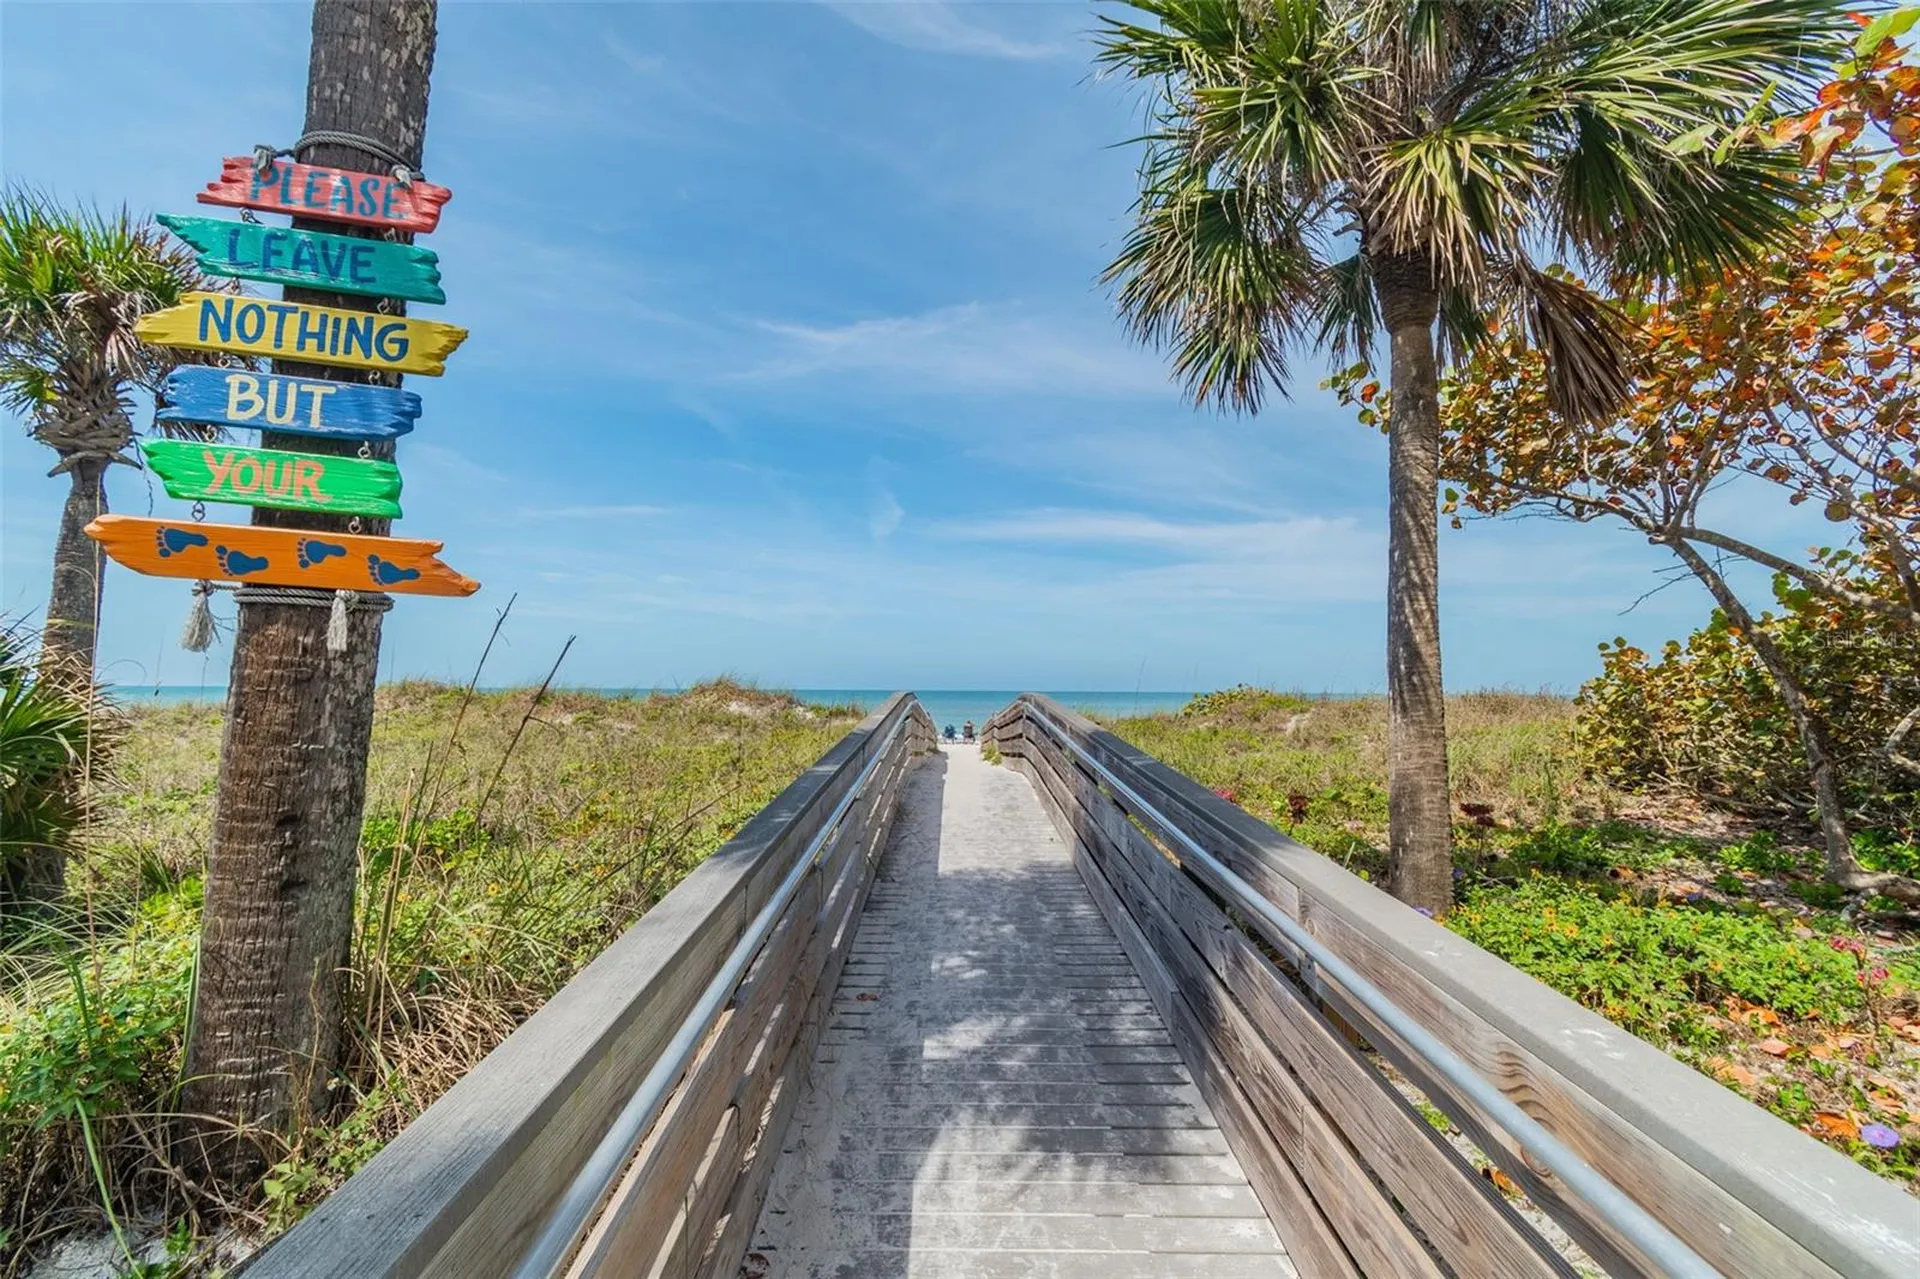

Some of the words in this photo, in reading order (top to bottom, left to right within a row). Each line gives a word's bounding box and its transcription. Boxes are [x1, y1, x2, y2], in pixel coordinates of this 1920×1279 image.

[250, 160, 407, 219] PLEASE
[228, 229, 376, 284] LEAVE
[199, 299, 410, 362] NOTHING
[226, 375, 336, 429] BUT
[204, 452, 331, 501] YOUR
